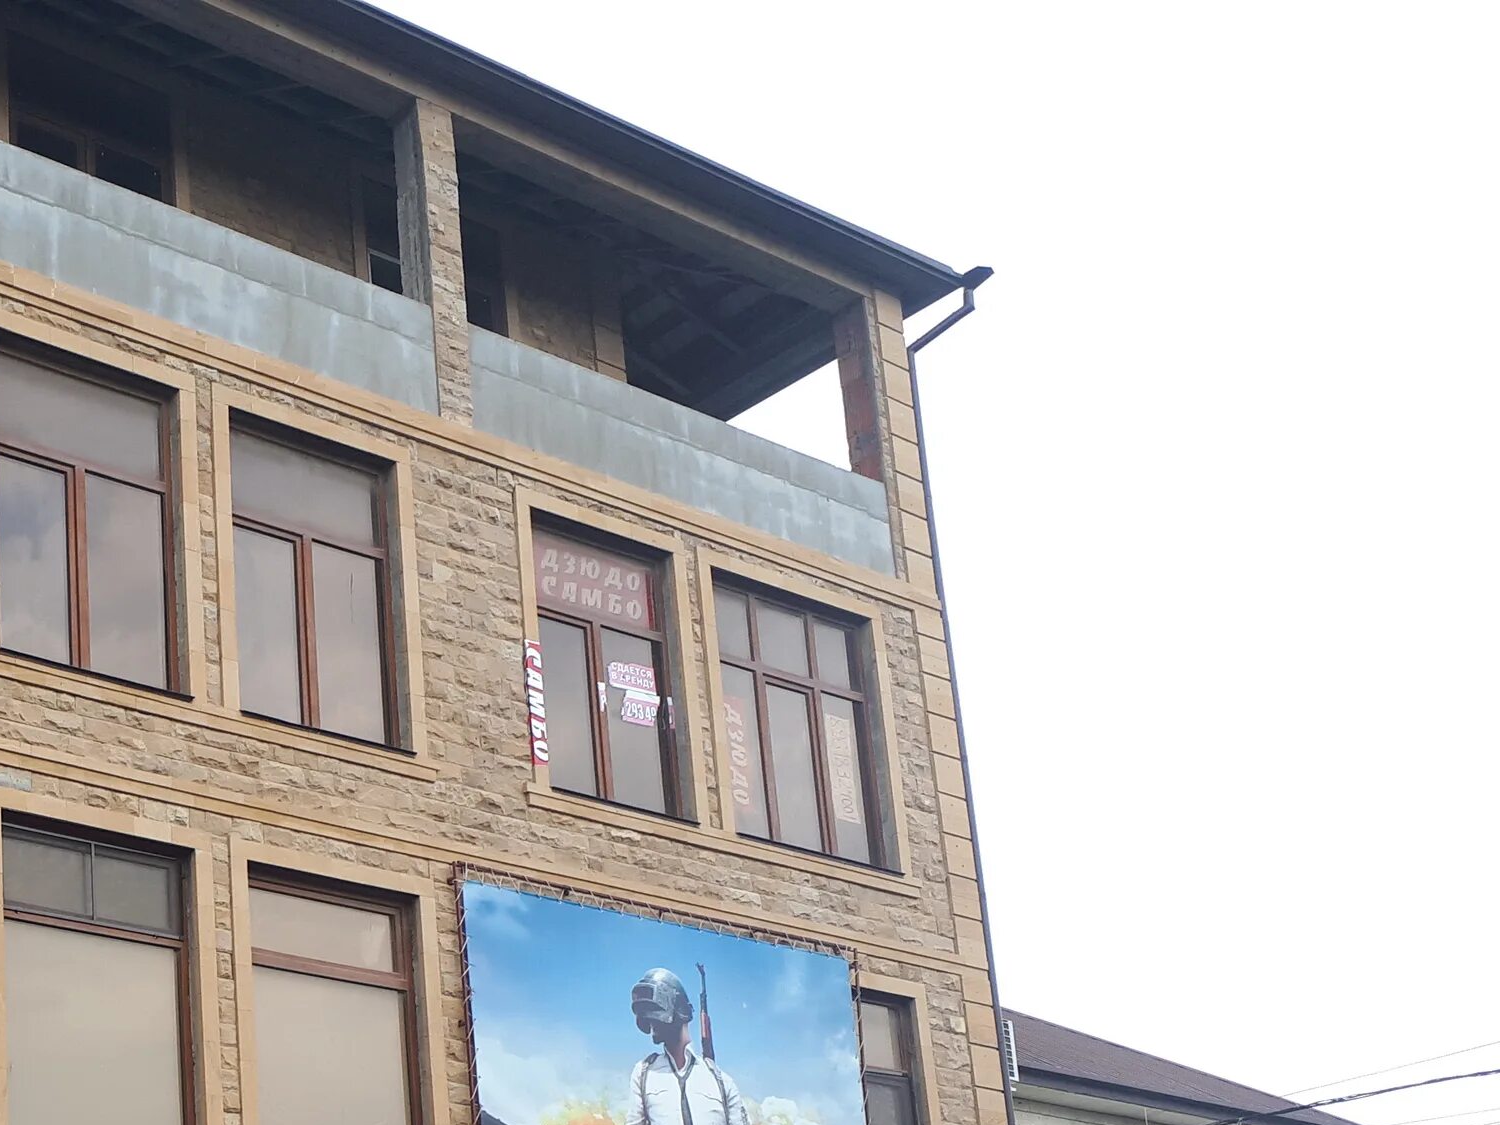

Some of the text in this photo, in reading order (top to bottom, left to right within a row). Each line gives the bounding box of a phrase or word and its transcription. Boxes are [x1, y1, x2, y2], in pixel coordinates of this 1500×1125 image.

[541, 549, 640, 591] ДЗЮДО
[541, 576, 642, 620] САМБО
[611, 662, 652, 679] СДАЕТСЯ
[611, 671, 617, 679] В
[724, 702, 751, 806] ДЗЮДО
